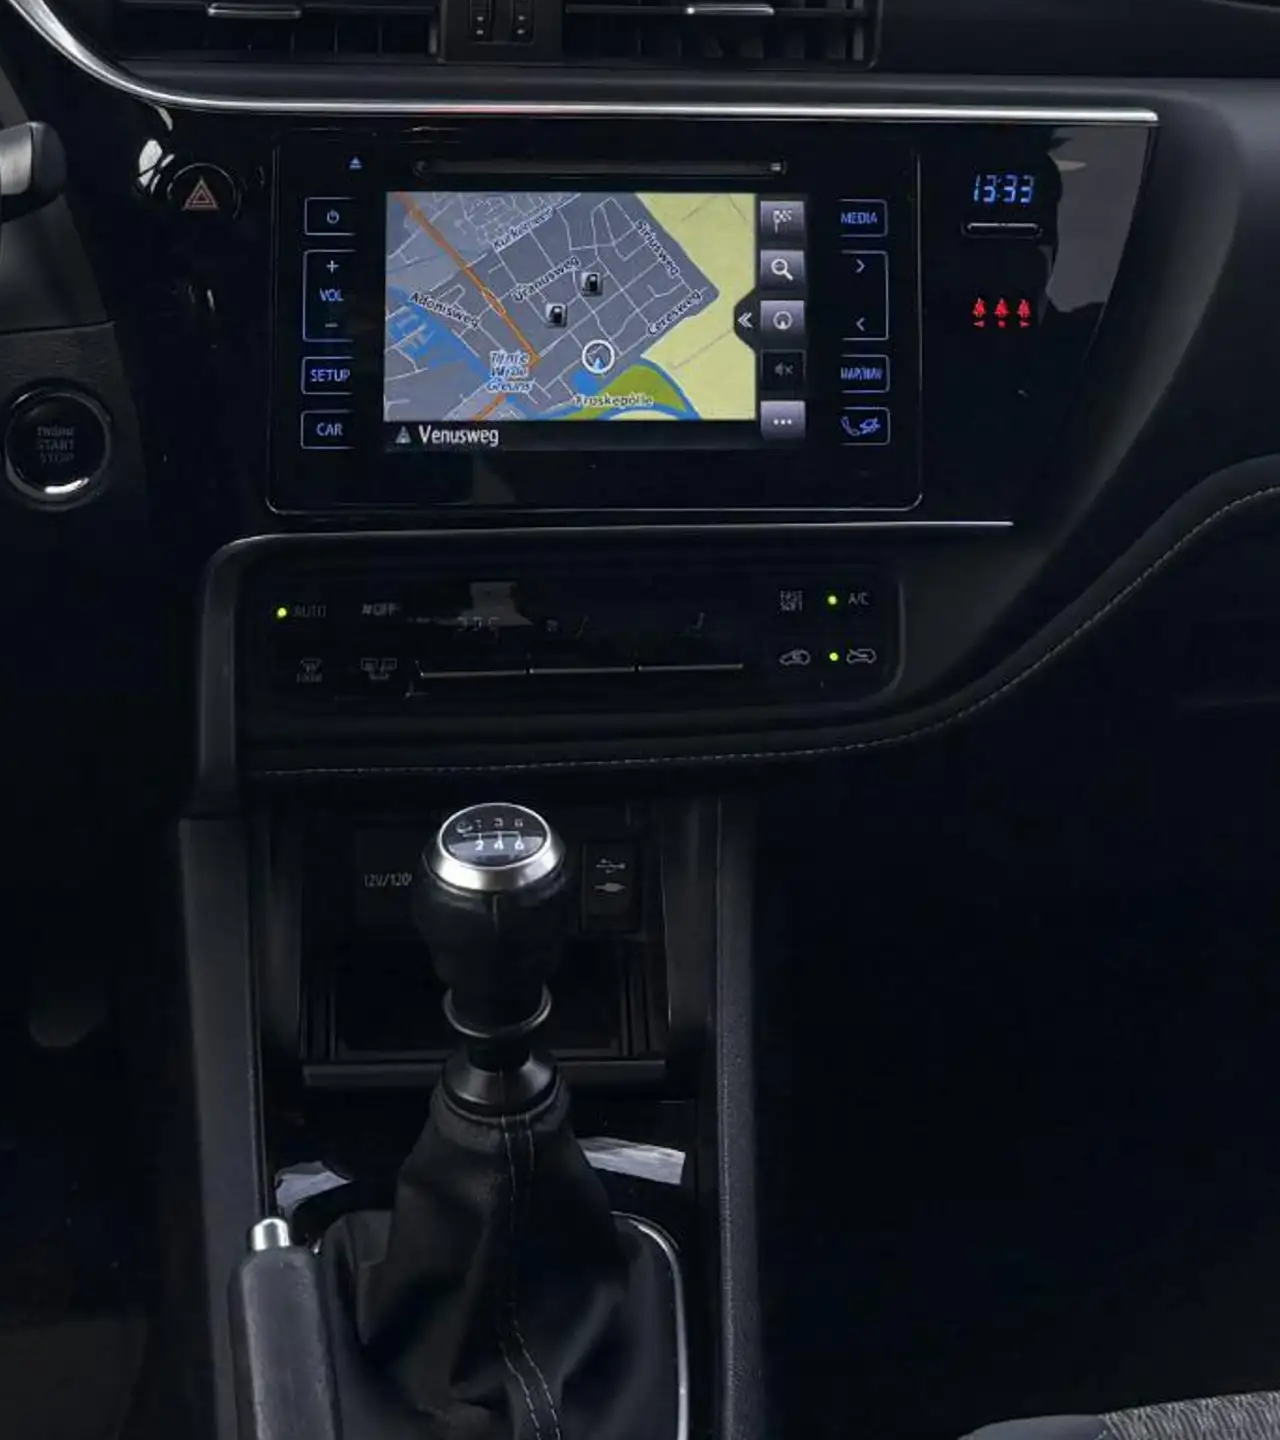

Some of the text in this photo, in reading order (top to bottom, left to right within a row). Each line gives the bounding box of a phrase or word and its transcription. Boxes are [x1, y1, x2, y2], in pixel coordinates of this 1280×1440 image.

[973, 174, 1035, 202] 13:33
[841, 212, 878, 224] MEDIA
[320, 288, 344, 301] VOL
[410, 292, 479, 330] Adonisweg
[310, 369, 351, 382] SETUP
[316, 422, 343, 436] CAR
[419, 426, 499, 447] Venusweg
